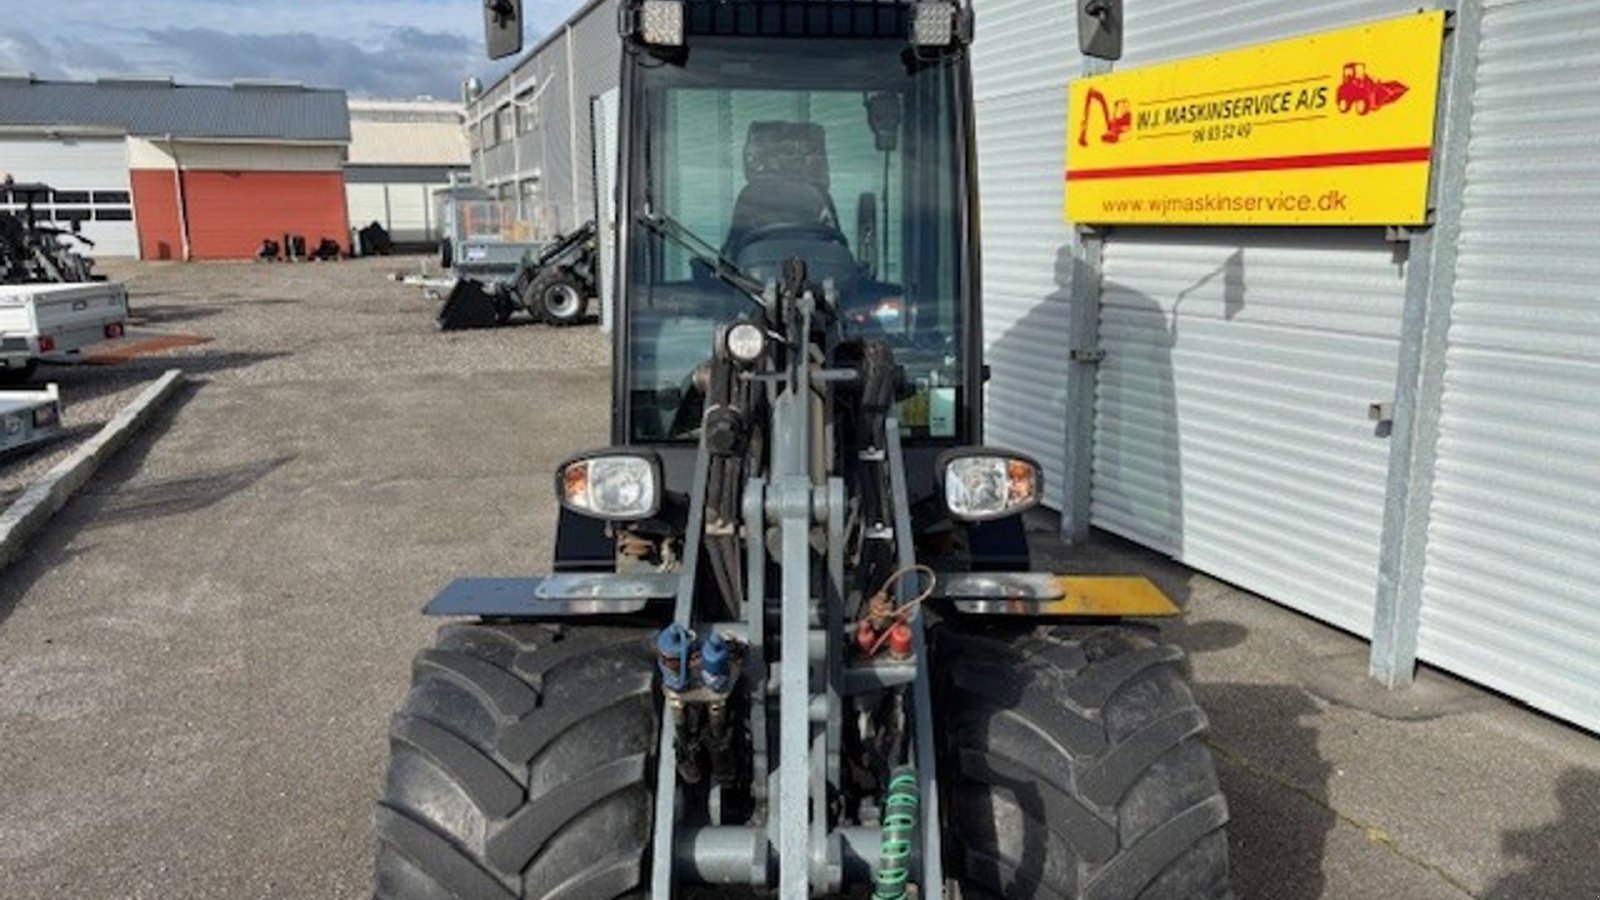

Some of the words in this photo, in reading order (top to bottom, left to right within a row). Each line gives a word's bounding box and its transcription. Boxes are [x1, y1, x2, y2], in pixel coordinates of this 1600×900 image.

[1165, 92, 1291, 124] MASKINSERVICE
[1296, 87, 1328, 111] A/S
[1222, 124, 1236, 140] 52
[1102, 191, 1347, 216] www.wjmaskinservice.dk
